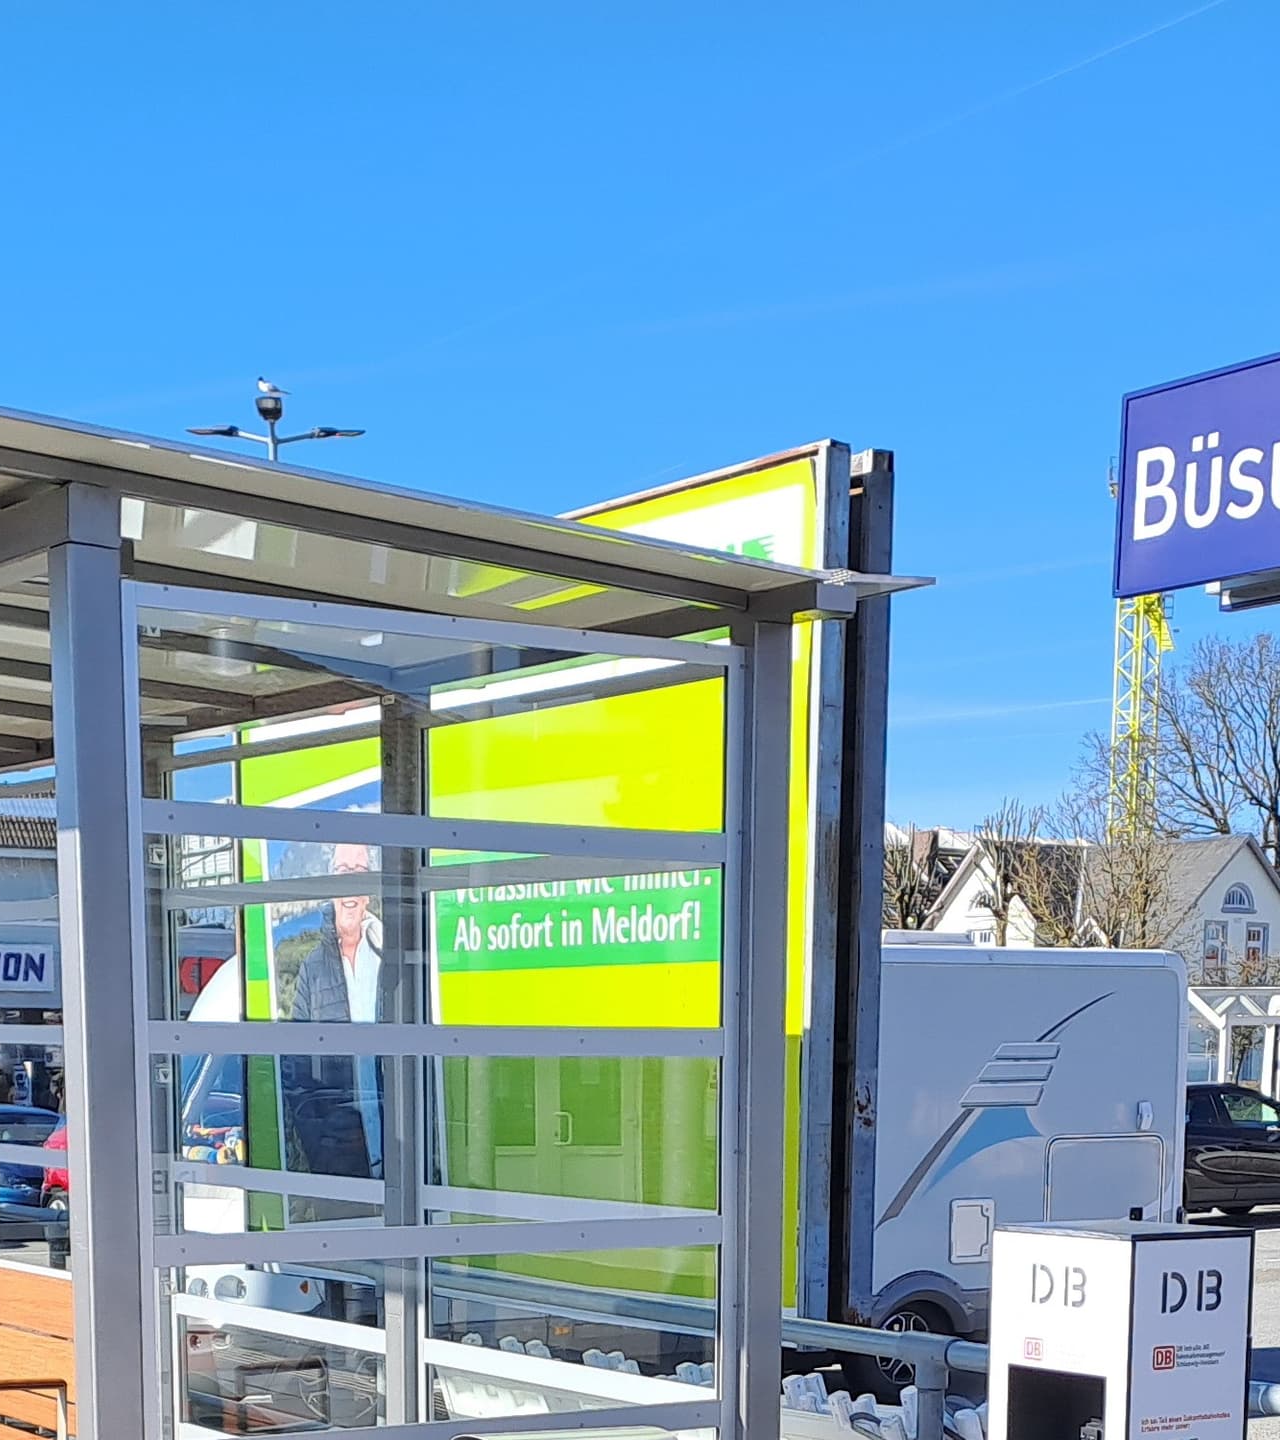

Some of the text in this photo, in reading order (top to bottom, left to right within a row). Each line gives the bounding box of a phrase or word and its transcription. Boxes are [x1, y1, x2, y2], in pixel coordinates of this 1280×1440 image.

[453, 900, 701, 952] Ab sofort in Meldorf!
[1031, 1263, 1087, 1308] DB
[1161, 1269, 1223, 1314] DB
[1025, 1340, 1042, 1357] DB
[1155, 1349, 1173, 1366] DB
